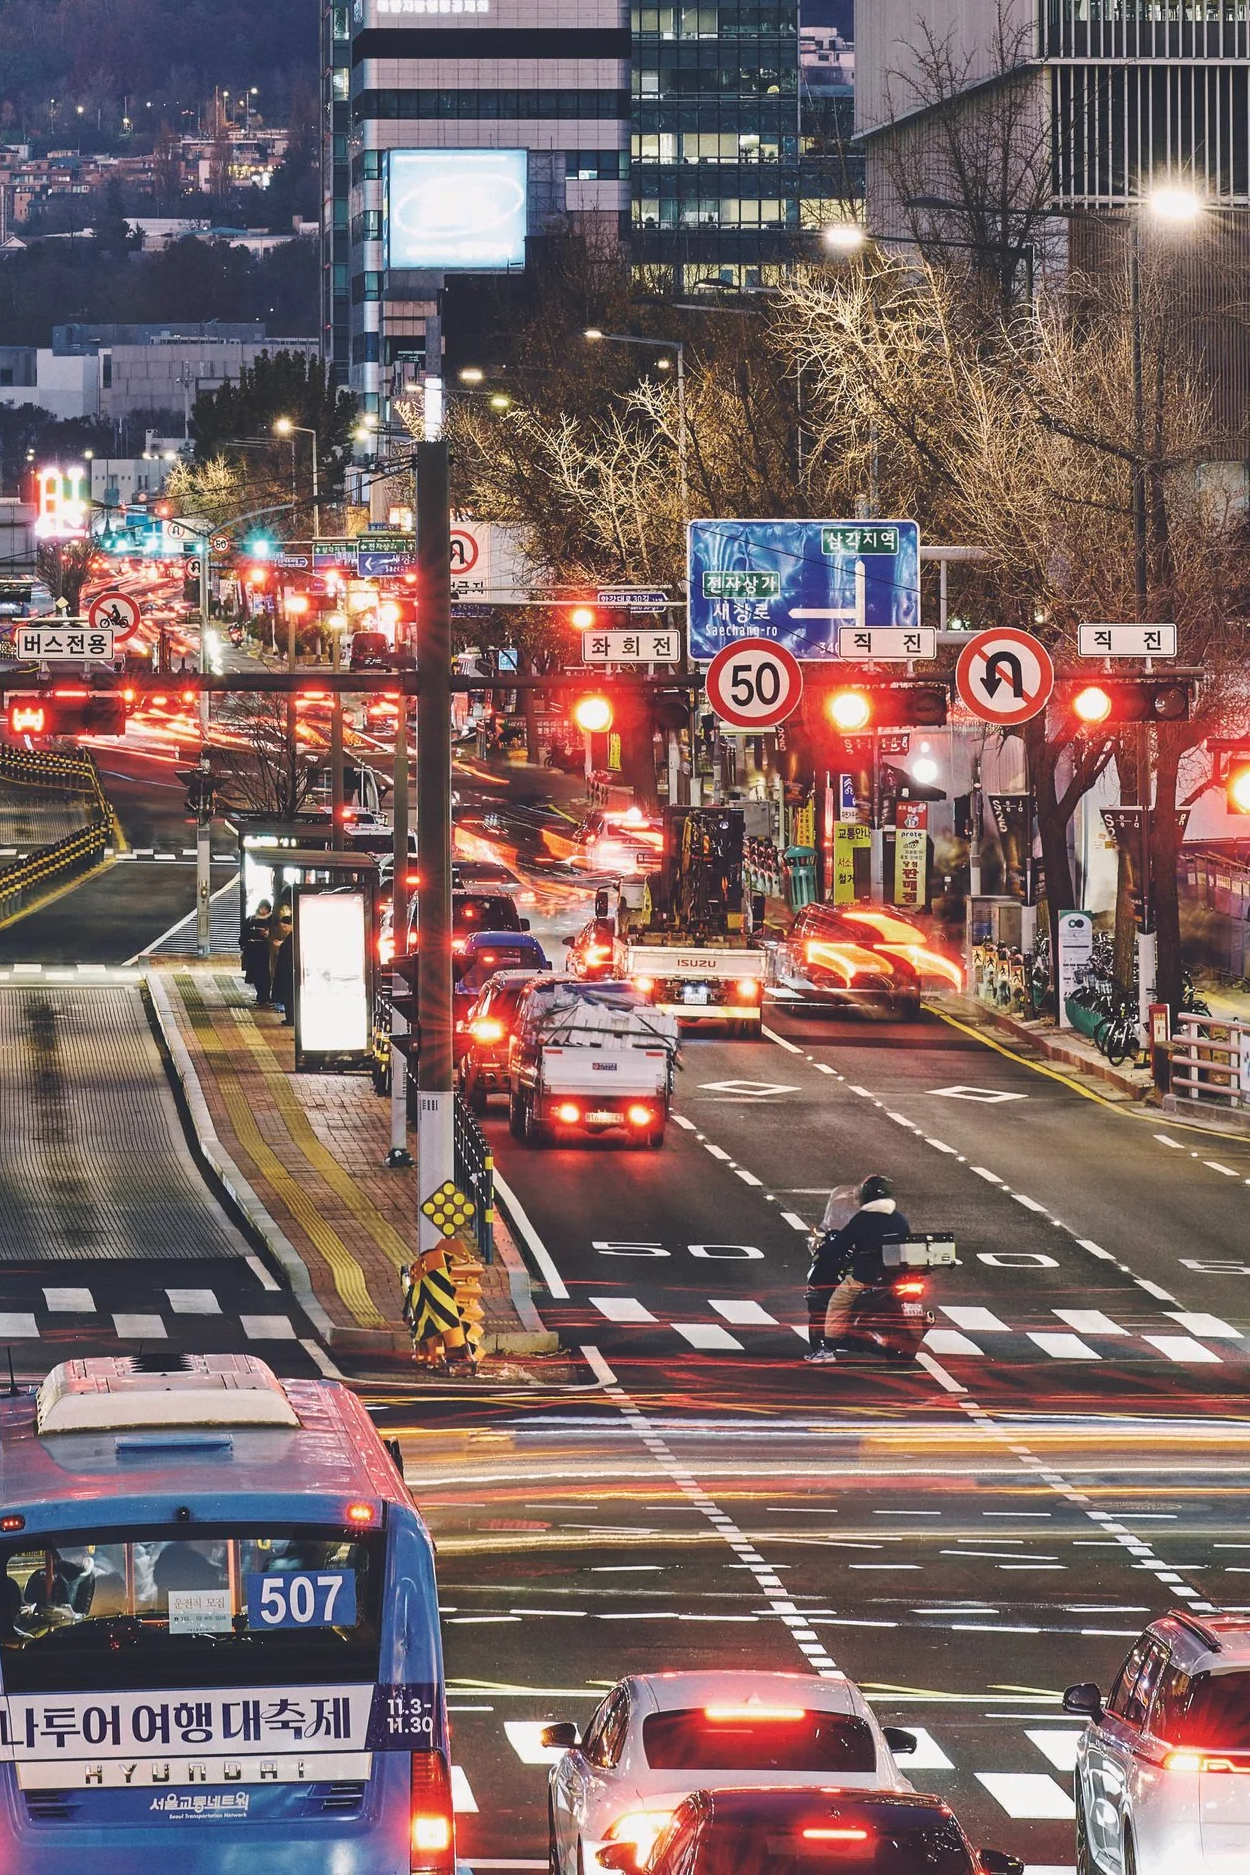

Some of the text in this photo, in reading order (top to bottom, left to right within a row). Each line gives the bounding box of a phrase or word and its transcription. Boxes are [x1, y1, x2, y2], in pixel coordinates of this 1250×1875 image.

[826, 531, 896, 551] 삼각지역
[707, 575, 779, 595] 전자상가
[713, 603, 771, 623] 새창로
[705, 624, 778, 637] Saechang-ro
[24, 633, 107, 655] 버스전용
[731, 662, 781, 707] 50
[837, 857, 854, 868] 서소
[677, 959, 716, 968] ISUZU
[591, 1241, 765, 1259] 50
[206, 1596, 225, 1609] 모집
[260, 1575, 343, 1624] 507
[132, 1702, 212, 1744] 여행
[222, 1697, 351, 1742] 대축제
[386, 1716, 434, 1734] 11.30
[85, 1759, 305, 1785] HYUNDAI
[185, 1812, 223, 1820] Transportation
